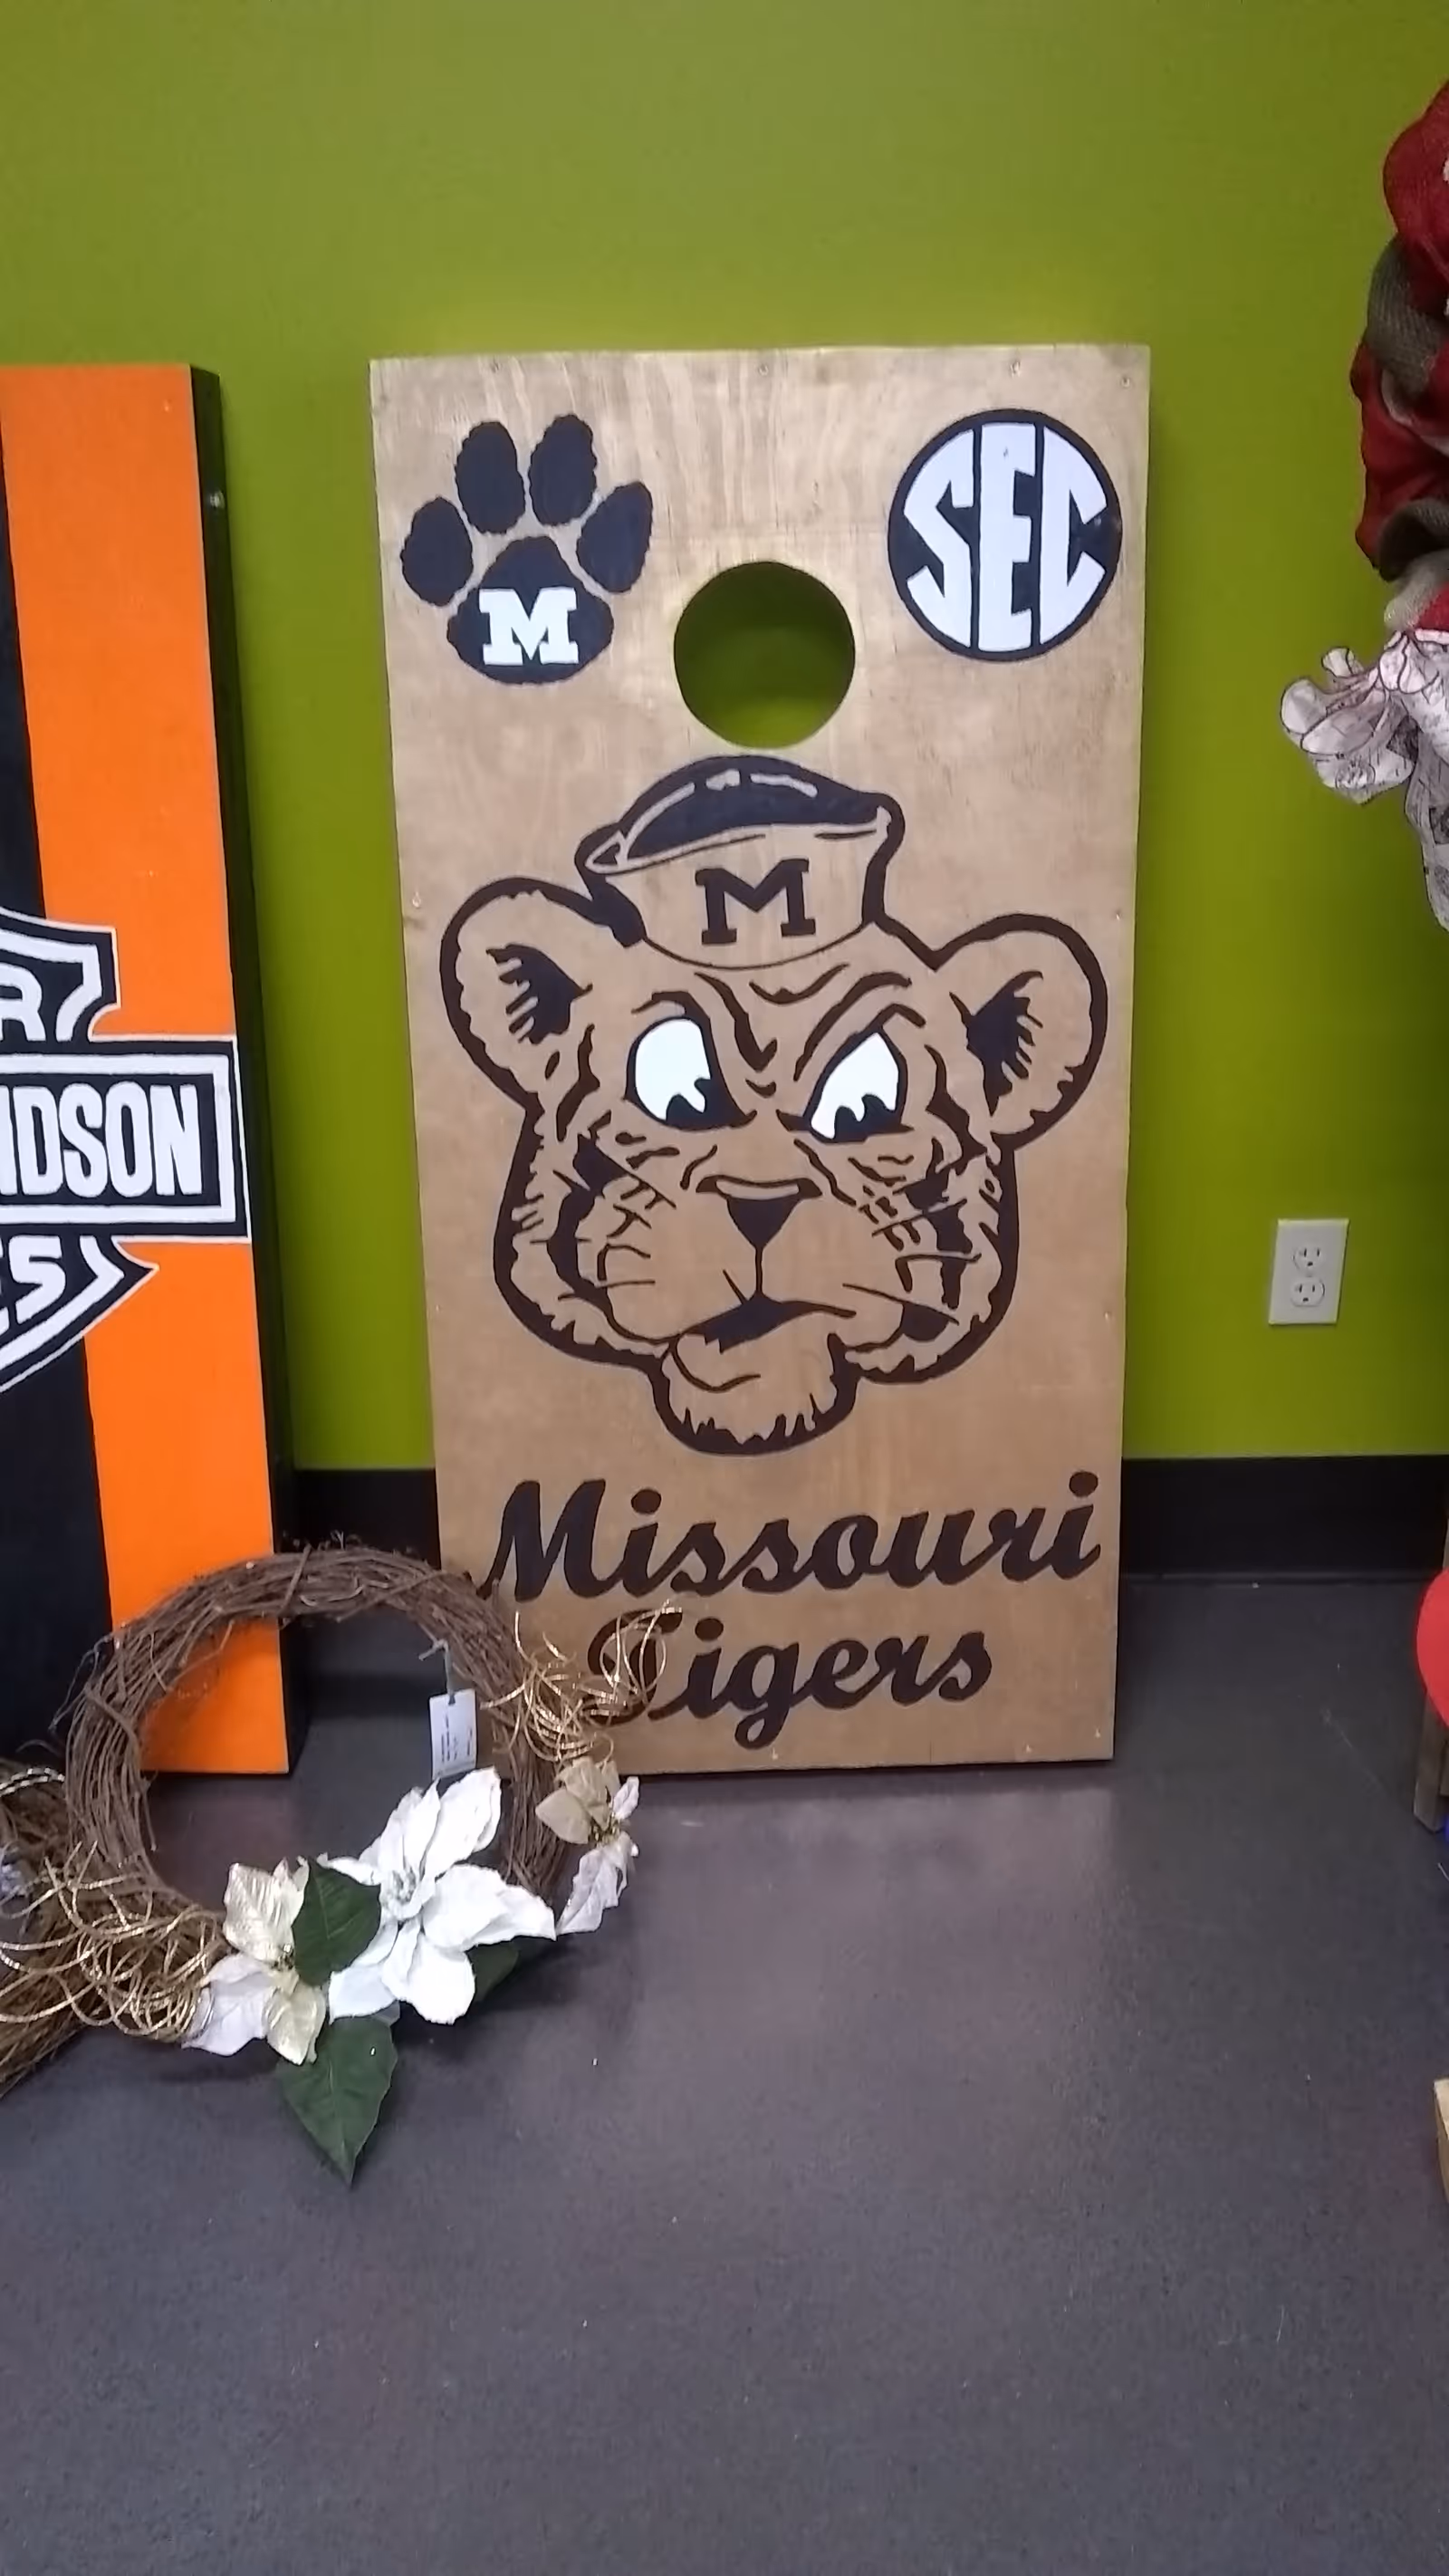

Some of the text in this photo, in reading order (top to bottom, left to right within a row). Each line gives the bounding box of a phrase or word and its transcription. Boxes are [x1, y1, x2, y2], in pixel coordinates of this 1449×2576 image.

[904, 423, 1108, 653] SEC
[479, 586, 579, 666] M
[695, 859, 816, 946] M
[479, 1471, 1101, 1602] Missouri
[584, 1608, 993, 1750] Tigers
